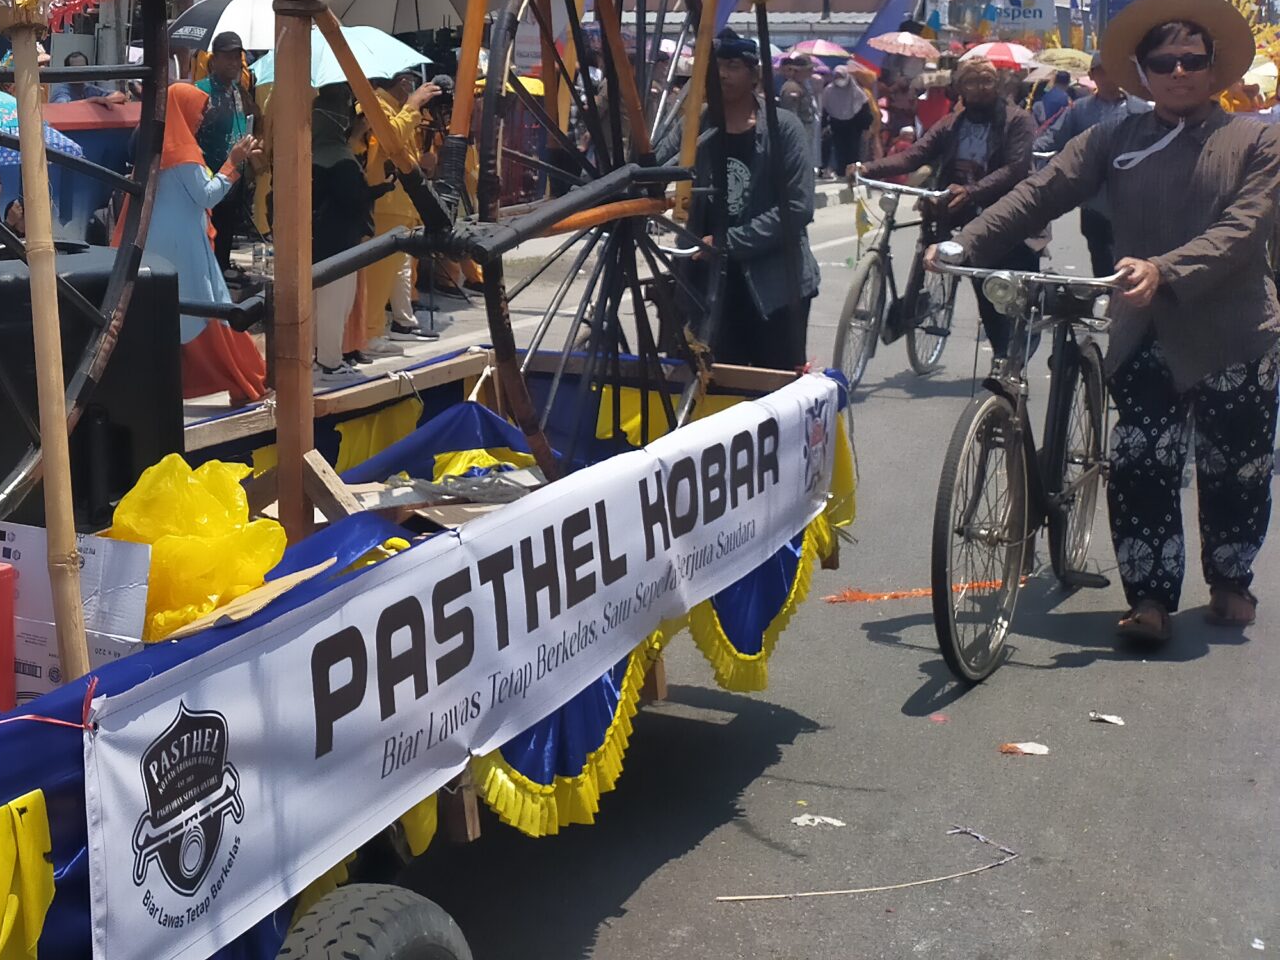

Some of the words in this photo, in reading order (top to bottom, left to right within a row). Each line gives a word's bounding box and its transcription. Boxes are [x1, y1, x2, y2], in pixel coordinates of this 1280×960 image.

[311, 499, 627, 759] PASTHEL
[381, 728, 424, 779] Biar
[426, 691, 481, 750] Lawas
[488, 662, 532, 709] Tetap
[536, 619, 598, 681] Berkelas,
[602, 597, 632, 634] Satu
[633, 560, 677, 614] Sepeda
[715, 519, 756, 560] Saudara
[149, 728, 219, 784] PASTHEL
[143, 889, 160, 919] Biar
[158, 907, 184, 929] Lawas
[186, 896, 210, 924] Tetap
[210, 835, 241, 899] Berkelas
